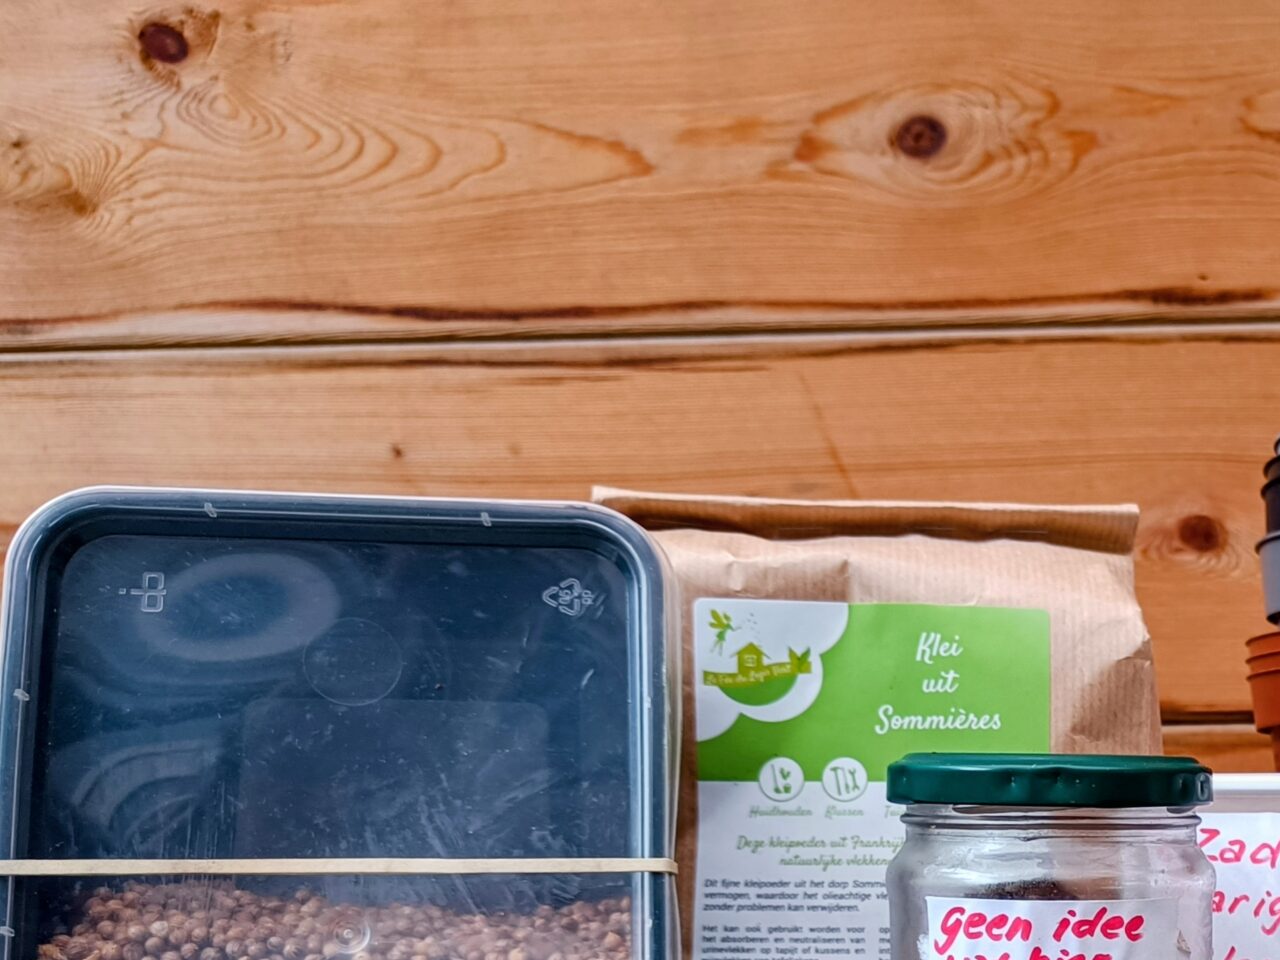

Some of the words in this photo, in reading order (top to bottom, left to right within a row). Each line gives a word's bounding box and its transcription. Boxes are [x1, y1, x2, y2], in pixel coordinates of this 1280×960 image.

[916, 632, 964, 664] Klei
[922, 670, 960, 693] uit
[875, 704, 1001, 734] Sommières
[830, 837, 847, 848] uit
[704, 879, 718, 888] Dit
[721, 878, 741, 889] fijne
[744, 879, 791, 889] kleipoeder
[794, 880, 806, 888] uit
[809, 880, 824, 888] het
[828, 880, 849, 889] dorp
[756, 891, 799, 900] waardoor
[803, 892, 818, 900] het
[822, 891, 871, 902] olieachtige
[703, 903, 735, 912] zonder
[736, 903, 785, 912] problemen
[787, 903, 804, 912] kan
[1053, 907, 1145, 941] idee
